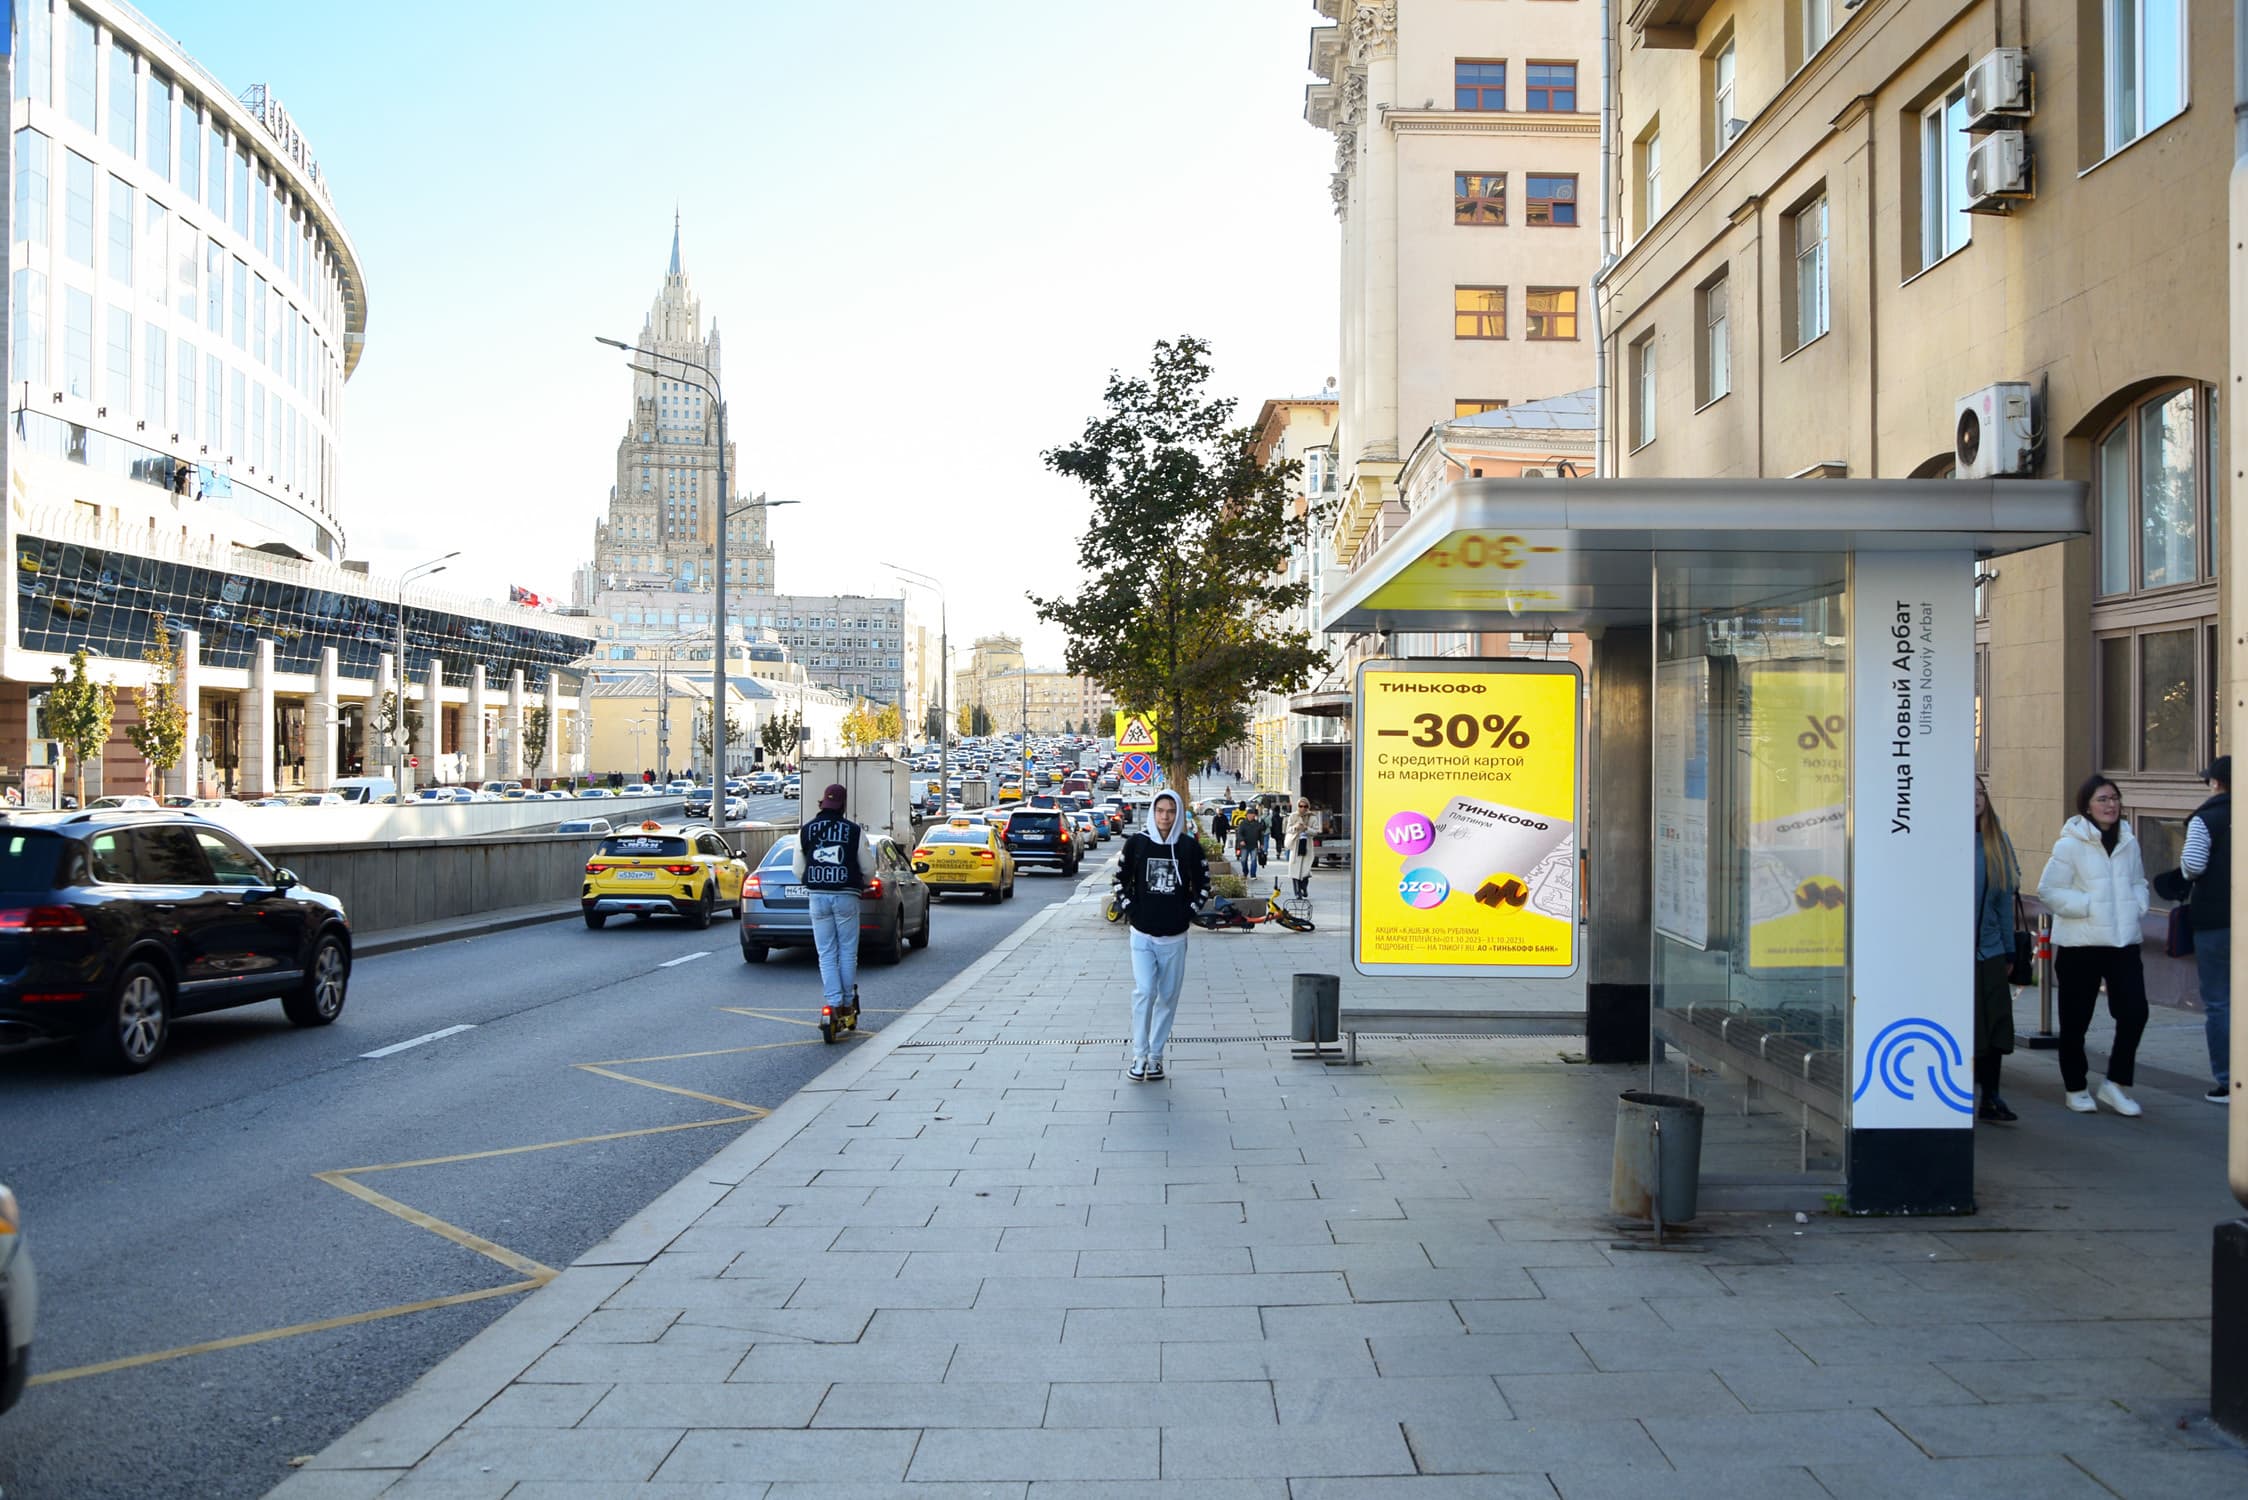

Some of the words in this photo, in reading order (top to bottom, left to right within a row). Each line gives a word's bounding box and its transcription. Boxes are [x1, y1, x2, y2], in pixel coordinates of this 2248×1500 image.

[1919, 602, 1933, 643] Arbat
[1891, 600, 1915, 671] Арбат
[1919, 647, 1935, 689] Noviy
[1379, 682, 1487, 694] ТИНЬКОФФ
[1892, 678, 1911, 757] Новый
[1919, 695, 1933, 735] Ulitsa
[1378, 753, 1389, 765] С
[1392, 754, 1470, 767] кредитной
[1474, 755, 1524, 768] картой
[1378, 770, 1395, 780] на
[1399, 769, 1512, 782] маркетплейсах
[1891, 763, 1913, 834] Улица
[1449, 811, 1493, 829] Платинум
[1457, 802, 1549, 831] ТИНЬКОФФ
[809, 820, 850, 842] PURE
[1386, 823, 1427, 845] WB
[807, 865, 848, 883] LOGIC
[1399, 880, 1447, 894] OZON
